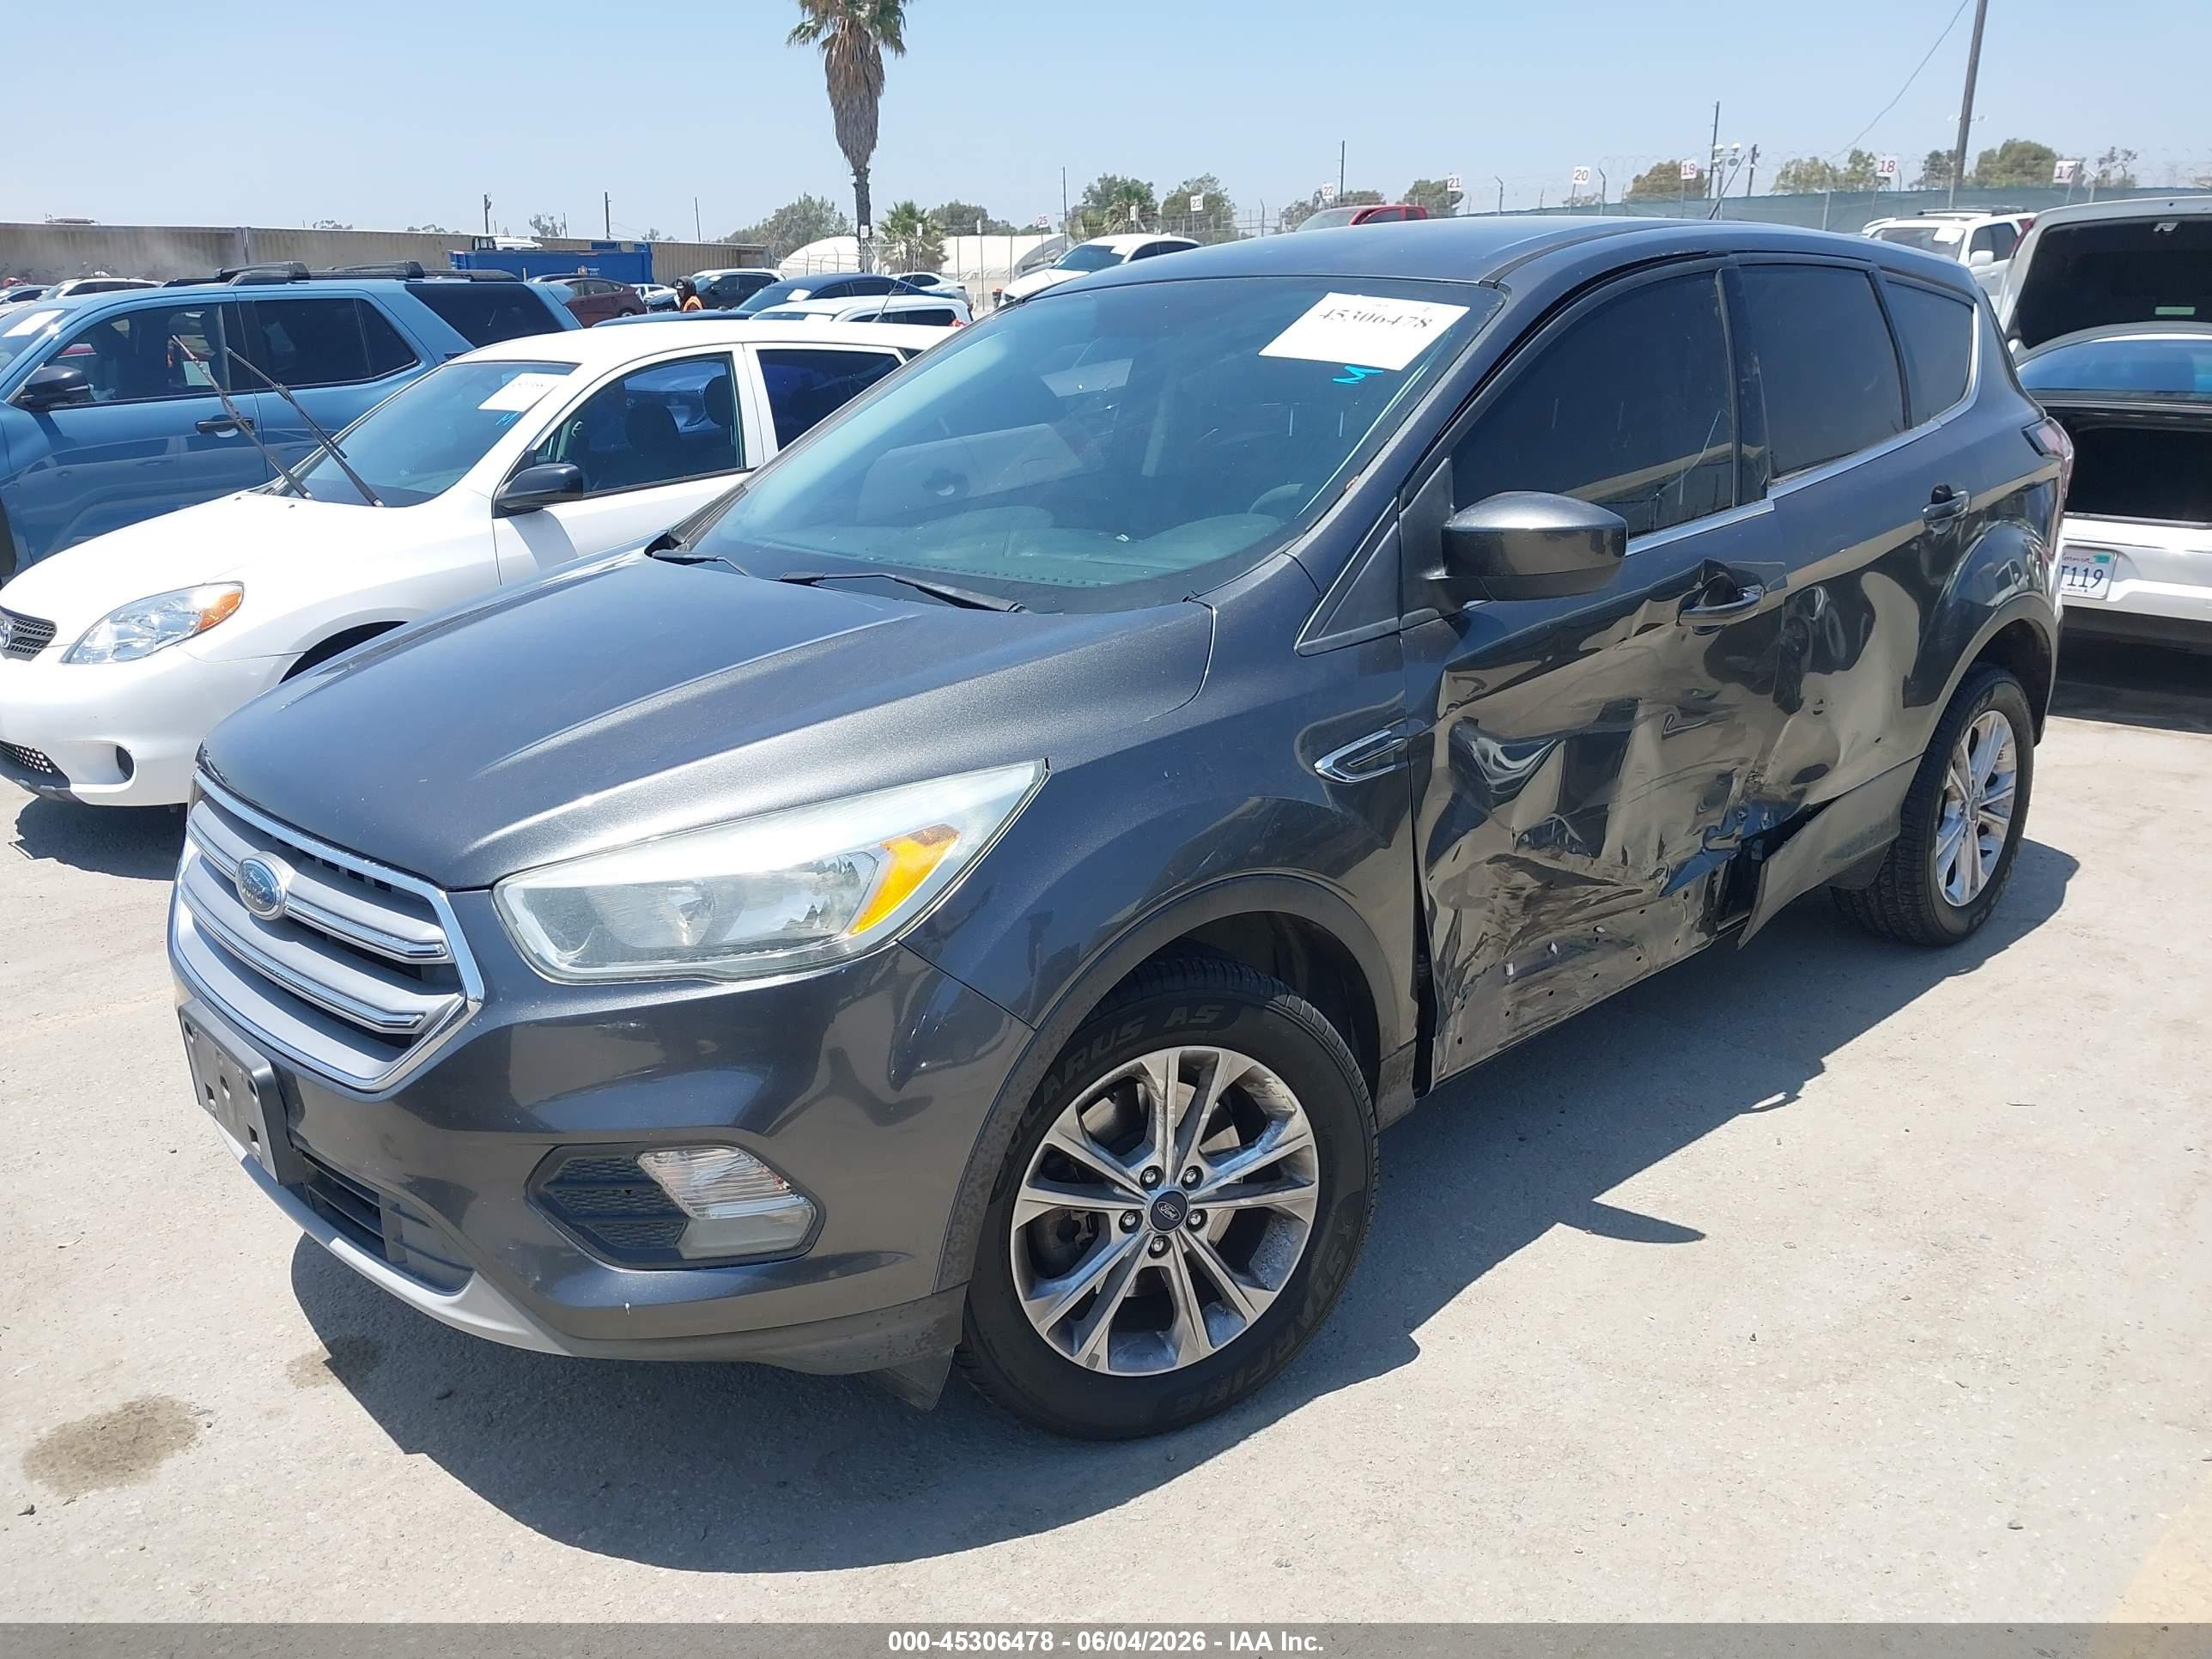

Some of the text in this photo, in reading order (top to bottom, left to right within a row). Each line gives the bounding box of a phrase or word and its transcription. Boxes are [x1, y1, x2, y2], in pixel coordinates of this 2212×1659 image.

[1682, 163, 1695, 176] 19
[1879, 160, 1895, 173] 18
[1574, 169, 1589, 181] 20
[2055, 167, 2075, 179] 17
[1449, 177, 1461, 188] 21
[1323, 185, 1334, 196] 22
[1192, 198, 1202, 209] 23
[1036, 216, 1048, 225] 25
[1318, 308, 1433, 329] 45306478
[1164, 1004, 1224, 1029] AS
[1159, 1203, 1179, 1219] Ford
